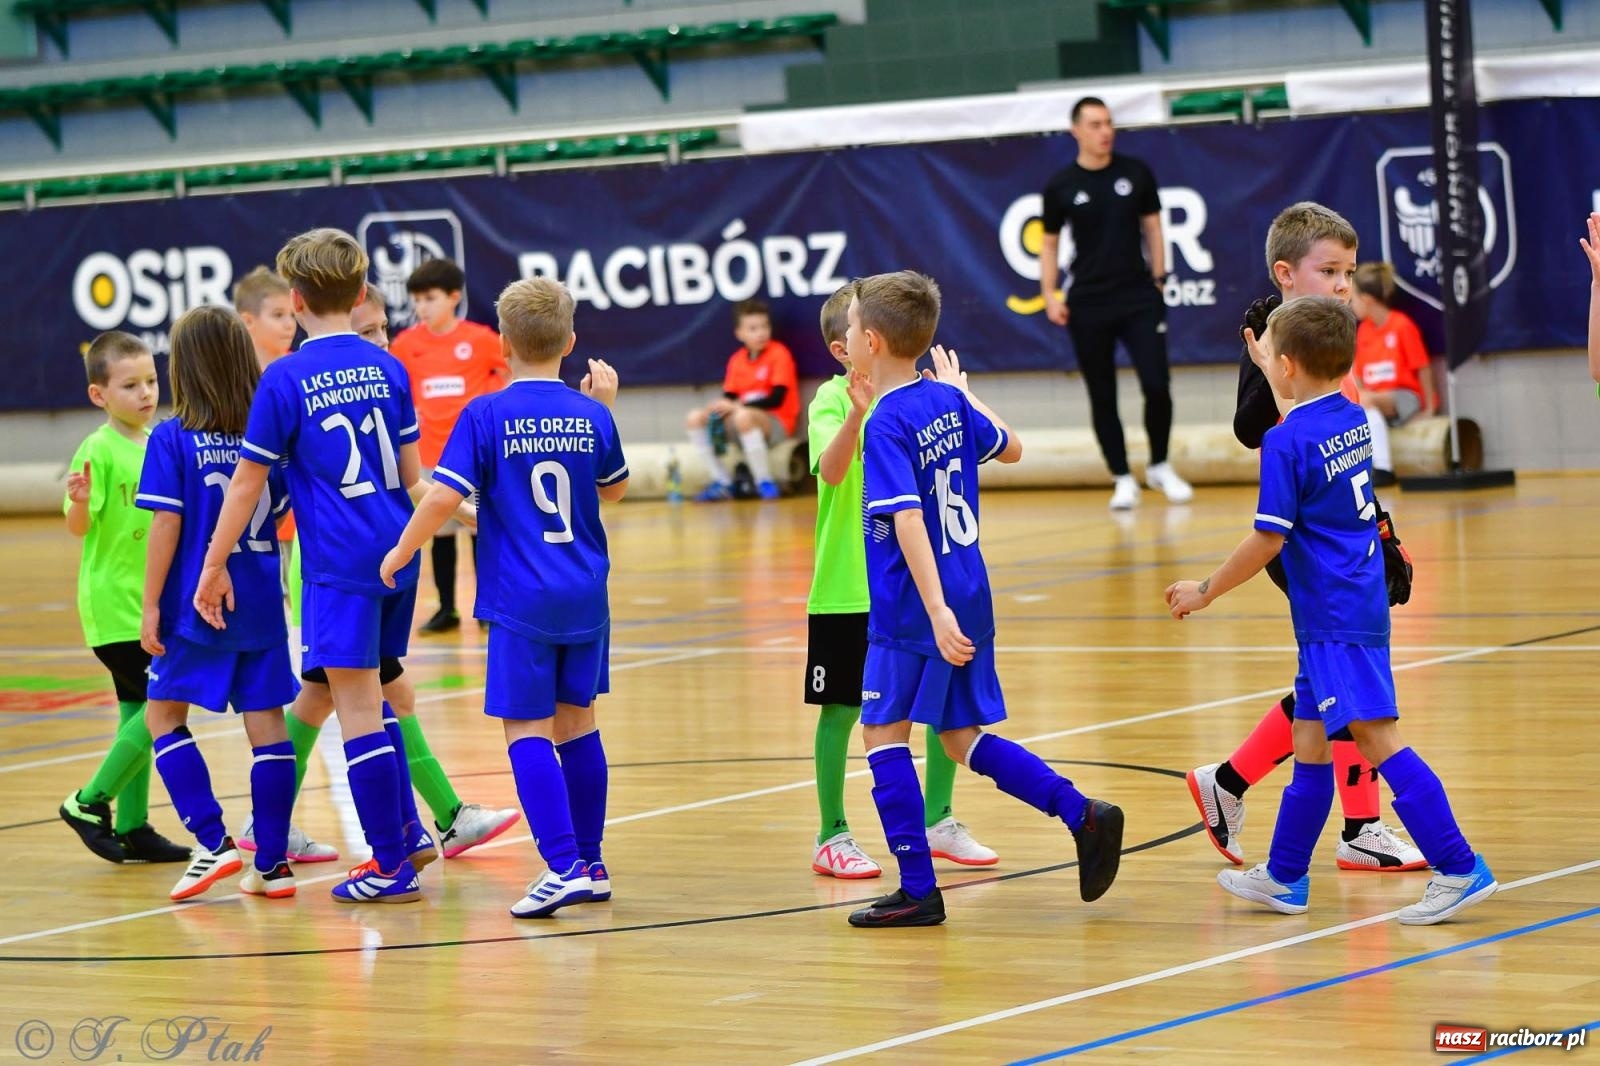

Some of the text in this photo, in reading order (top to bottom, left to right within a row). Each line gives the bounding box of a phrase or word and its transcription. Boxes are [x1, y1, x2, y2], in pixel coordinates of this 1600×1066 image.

[999, 186, 1214, 281] OR
[302, 366, 386, 394] LKS ORZEŁ
[305, 383, 391, 416] JANKOWICE
[193, 432, 223, 448] LKS
[504, 417, 594, 435] LKS ORZEŁ
[1318, 423, 1371, 458] LKS ORZE
[196, 448, 241, 470] JANKO
[320, 407, 401, 499] 21
[503, 436, 595, 459] JANKOWICE
[530, 460, 575, 543] 9
[1350, 469, 1376, 557] 5
[811, 665, 826, 693] 8
